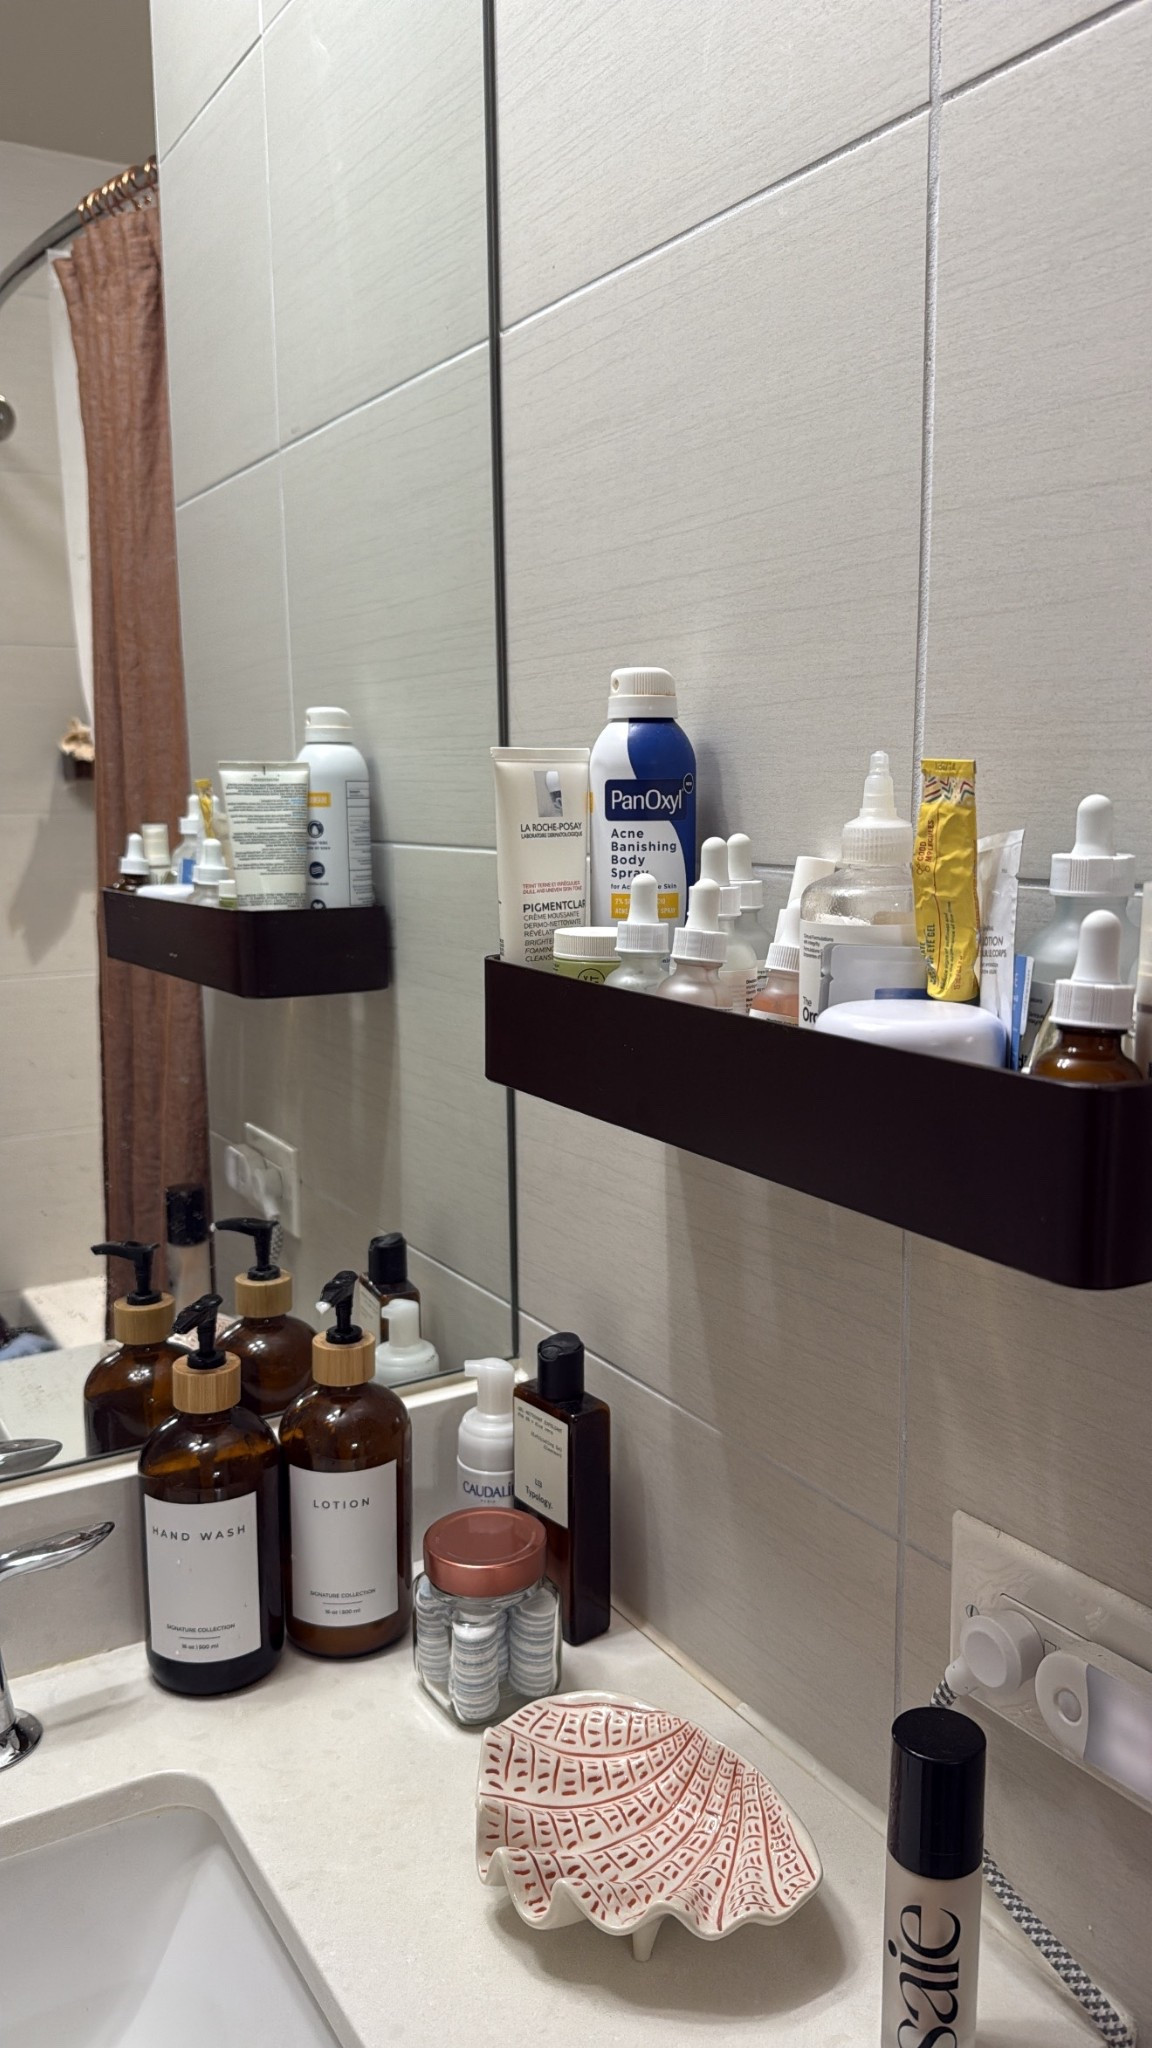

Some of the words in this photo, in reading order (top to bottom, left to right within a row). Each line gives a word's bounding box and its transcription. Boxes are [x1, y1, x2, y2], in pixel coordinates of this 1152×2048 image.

[611, 789, 682, 814] PanOxyl
[520, 824, 531, 832] LA
[532, 822, 582, 831] ROCHE-POSAY
[611, 829, 644, 838] Acne
[611, 841, 677, 853] Banishing
[917, 841, 927, 861] GOOD
[611, 854, 645, 866] Body
[523, 912, 546, 922] CRÈME
[547, 910, 579, 920] MOUSSANTE
[523, 918, 582, 930] DERMO-NETTOYANTE
[523, 928, 555, 937] RÉVÉLAT
[926, 923, 935, 938] GEL
[524, 938, 554, 946] BRIGHTE
[926, 940, 935, 953] EYE
[525, 954, 554, 962] CLEANS
[803, 995, 812, 1006] The
[313, 1497, 369, 1509] LOTION
[152, 1526, 190, 1541] HAND
[200, 1525, 245, 1541] WASH
[310, 1590, 339, 1598] SIGNATURE
[341, 1588, 376, 1599] COLLECTION
[166, 1623, 196, 1632] SIGNATURE
[198, 1623, 235, 1633] COLLECTION
